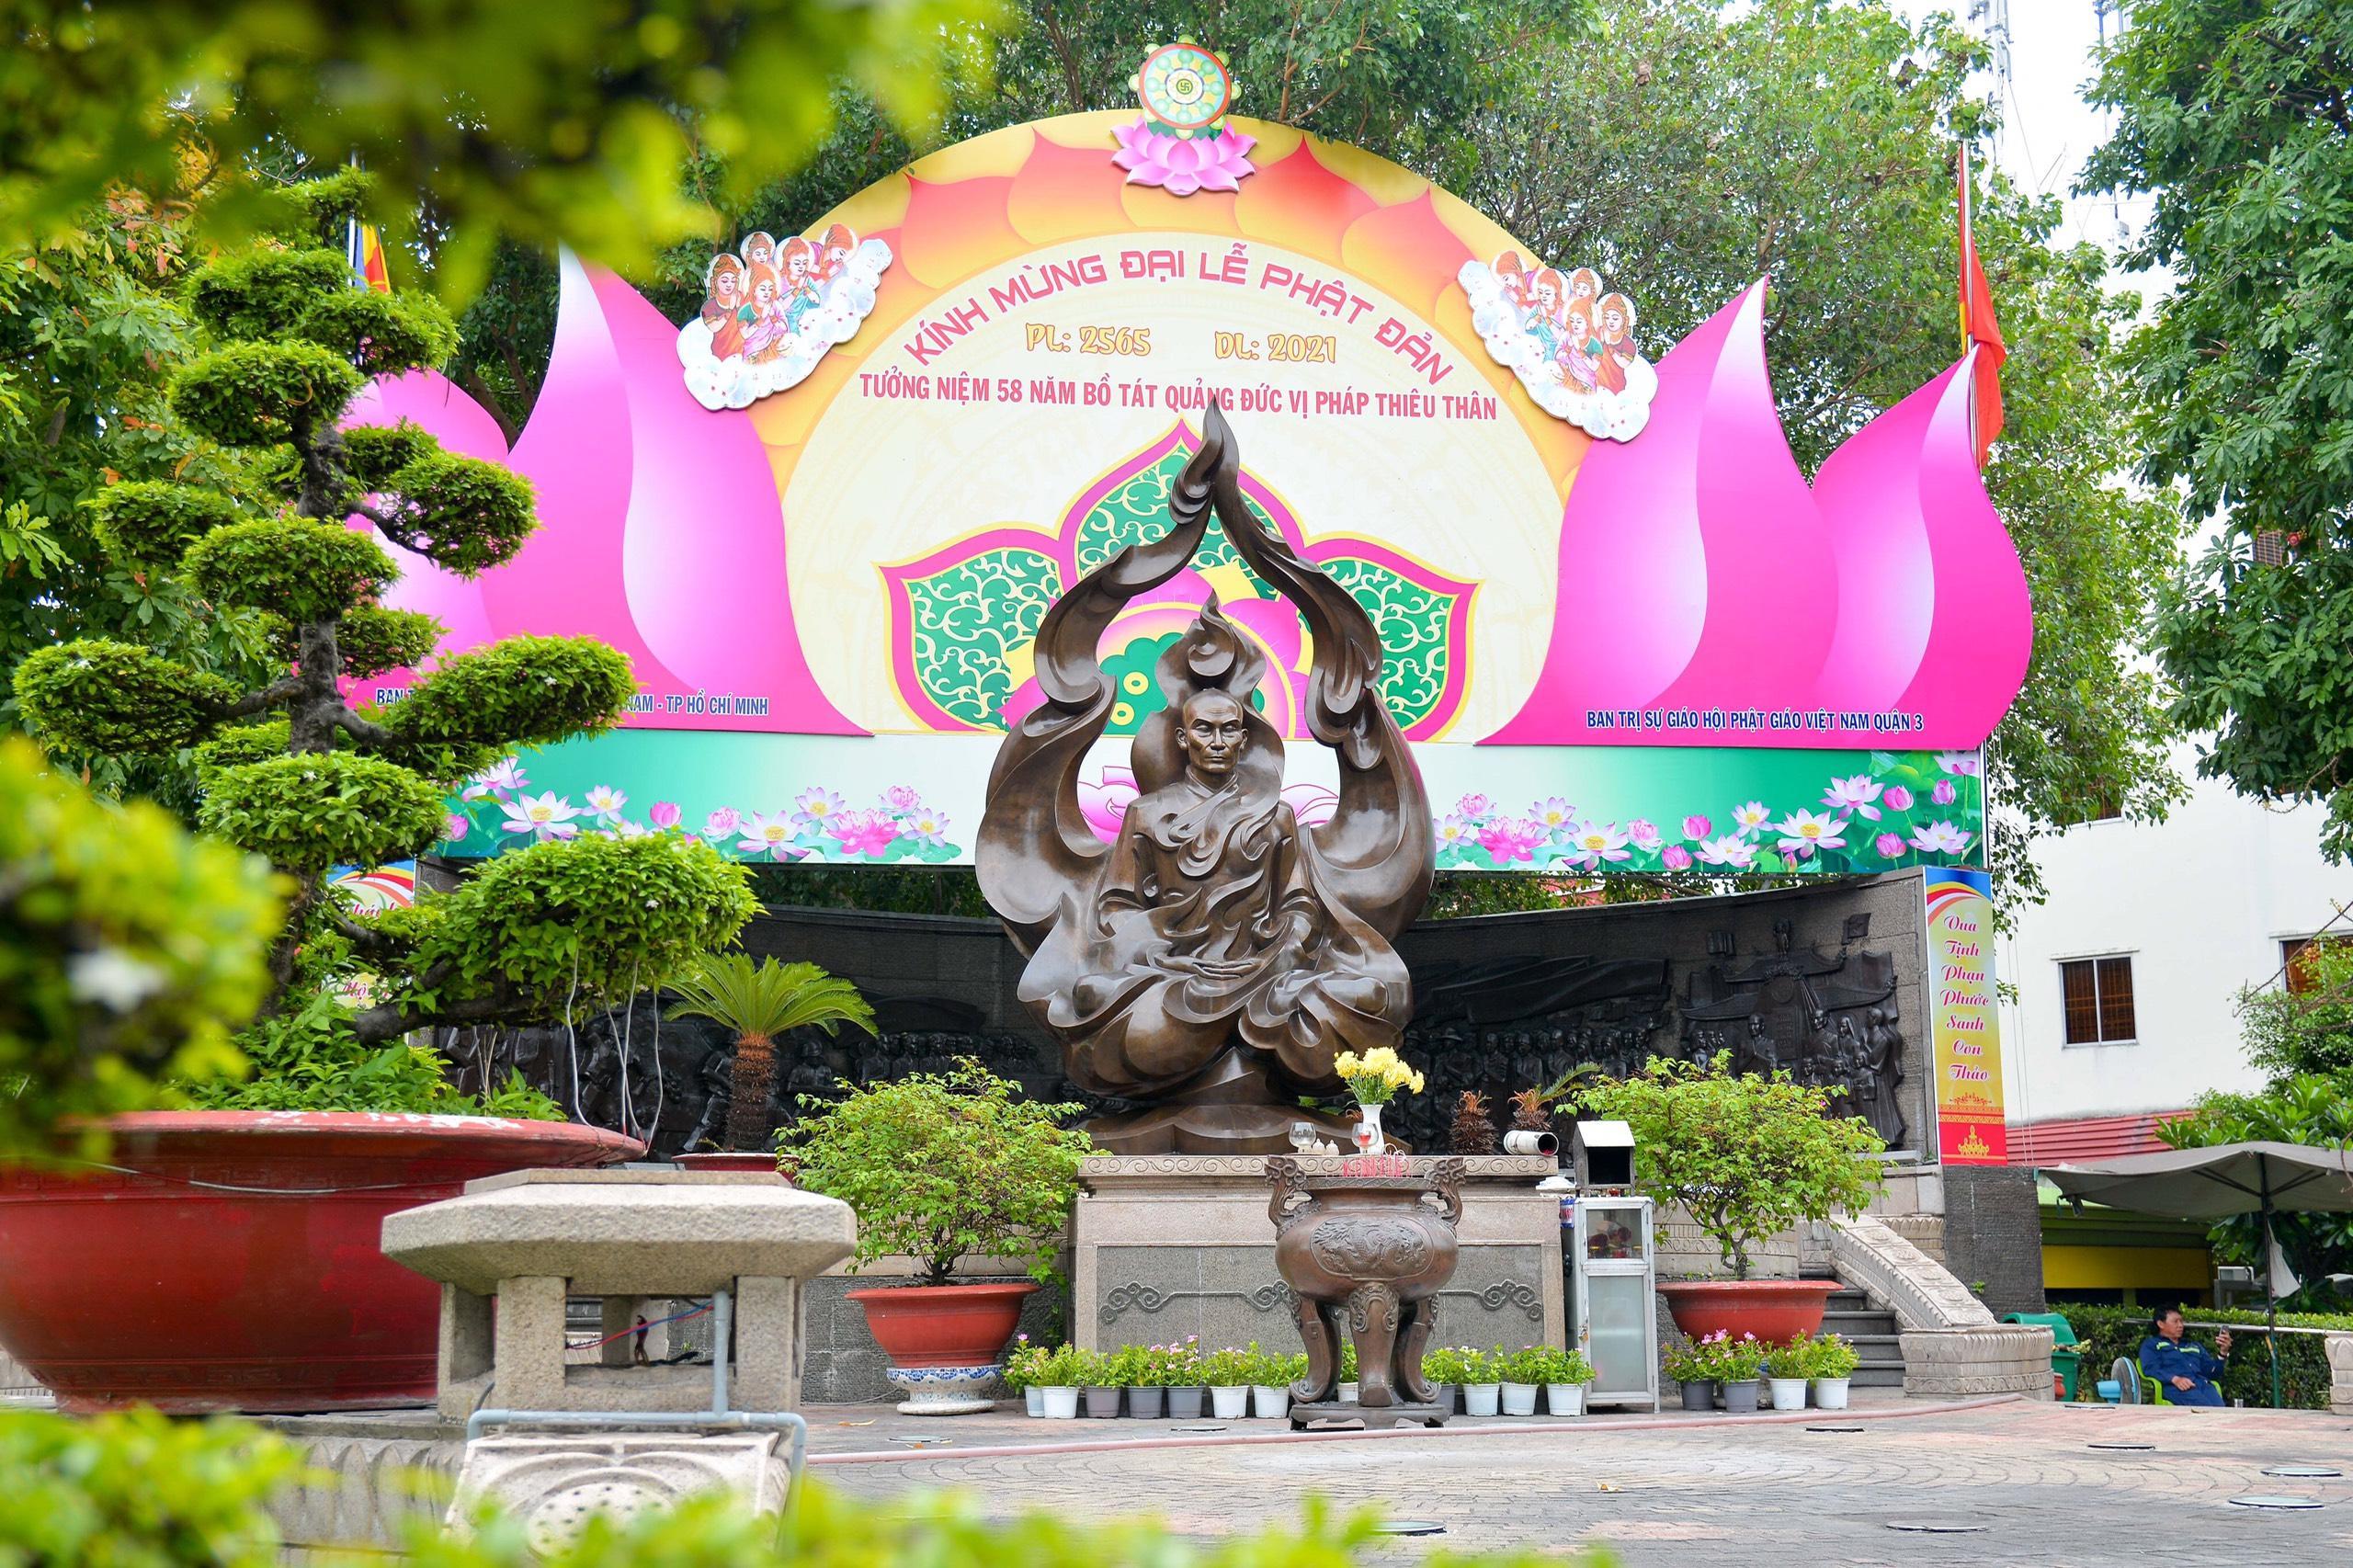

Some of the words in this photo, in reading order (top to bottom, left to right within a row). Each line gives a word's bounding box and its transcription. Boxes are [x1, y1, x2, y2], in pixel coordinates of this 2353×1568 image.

[904, 298, 990, 366] KÍNH
[1120, 250, 1184, 282] ĐẠI
[1199, 242, 1248, 285] LỄ
[1259, 263, 1375, 324] PHẬT
[1374, 317, 1454, 385] ĐẢN
[1025, 322, 1071, 353] PL:
[1079, 325, 1151, 357] 2565
[1214, 331, 1260, 360] DL:
[1267, 334, 1336, 364] 2021
[859, 365, 929, 399] TƯỞNG
[938, 370, 990, 405] NIỆM
[997, 379, 1023, 403] 58
[1029, 376, 1075, 404] NĂM
[1083, 372, 1111, 407] BỒ
[1119, 378, 1158, 408] TÁT
[1165, 378, 1234, 414] QUẢNG
[1241, 382, 1282, 413] ĐỨC
[1289, 390, 1308, 419] VỊ
[1315, 385, 1370, 415] PHÁP
[1375, 388, 1436, 418] THIÊU
[1442, 391, 1496, 420] THÂN
[666, 696, 683, 713] TP
[687, 689, 705, 713] HỒ
[710, 693, 732, 714] CHÍ
[735, 698, 768, 715] MINH
[1586, 710, 1614, 728] BAN
[1618, 710, 1641, 731] TRỊ
[1645, 709, 1664, 731] SỰ
[1667, 707, 1699, 728] GIÁO
[1703, 708, 1726, 732] HỘI
[1731, 708, 1765, 732] PHẬT
[1769, 707, 1801, 729] GIÁO
[1805, 708, 1835, 733] VIỆT
[1840, 713, 1870, 730] NAM
[1874, 710, 1910, 733] QUẬN
[1914, 714, 1923, 730] 3
[1944, 915, 1977, 931] Vua
[1946, 1014, 1984, 1030] Sanh
